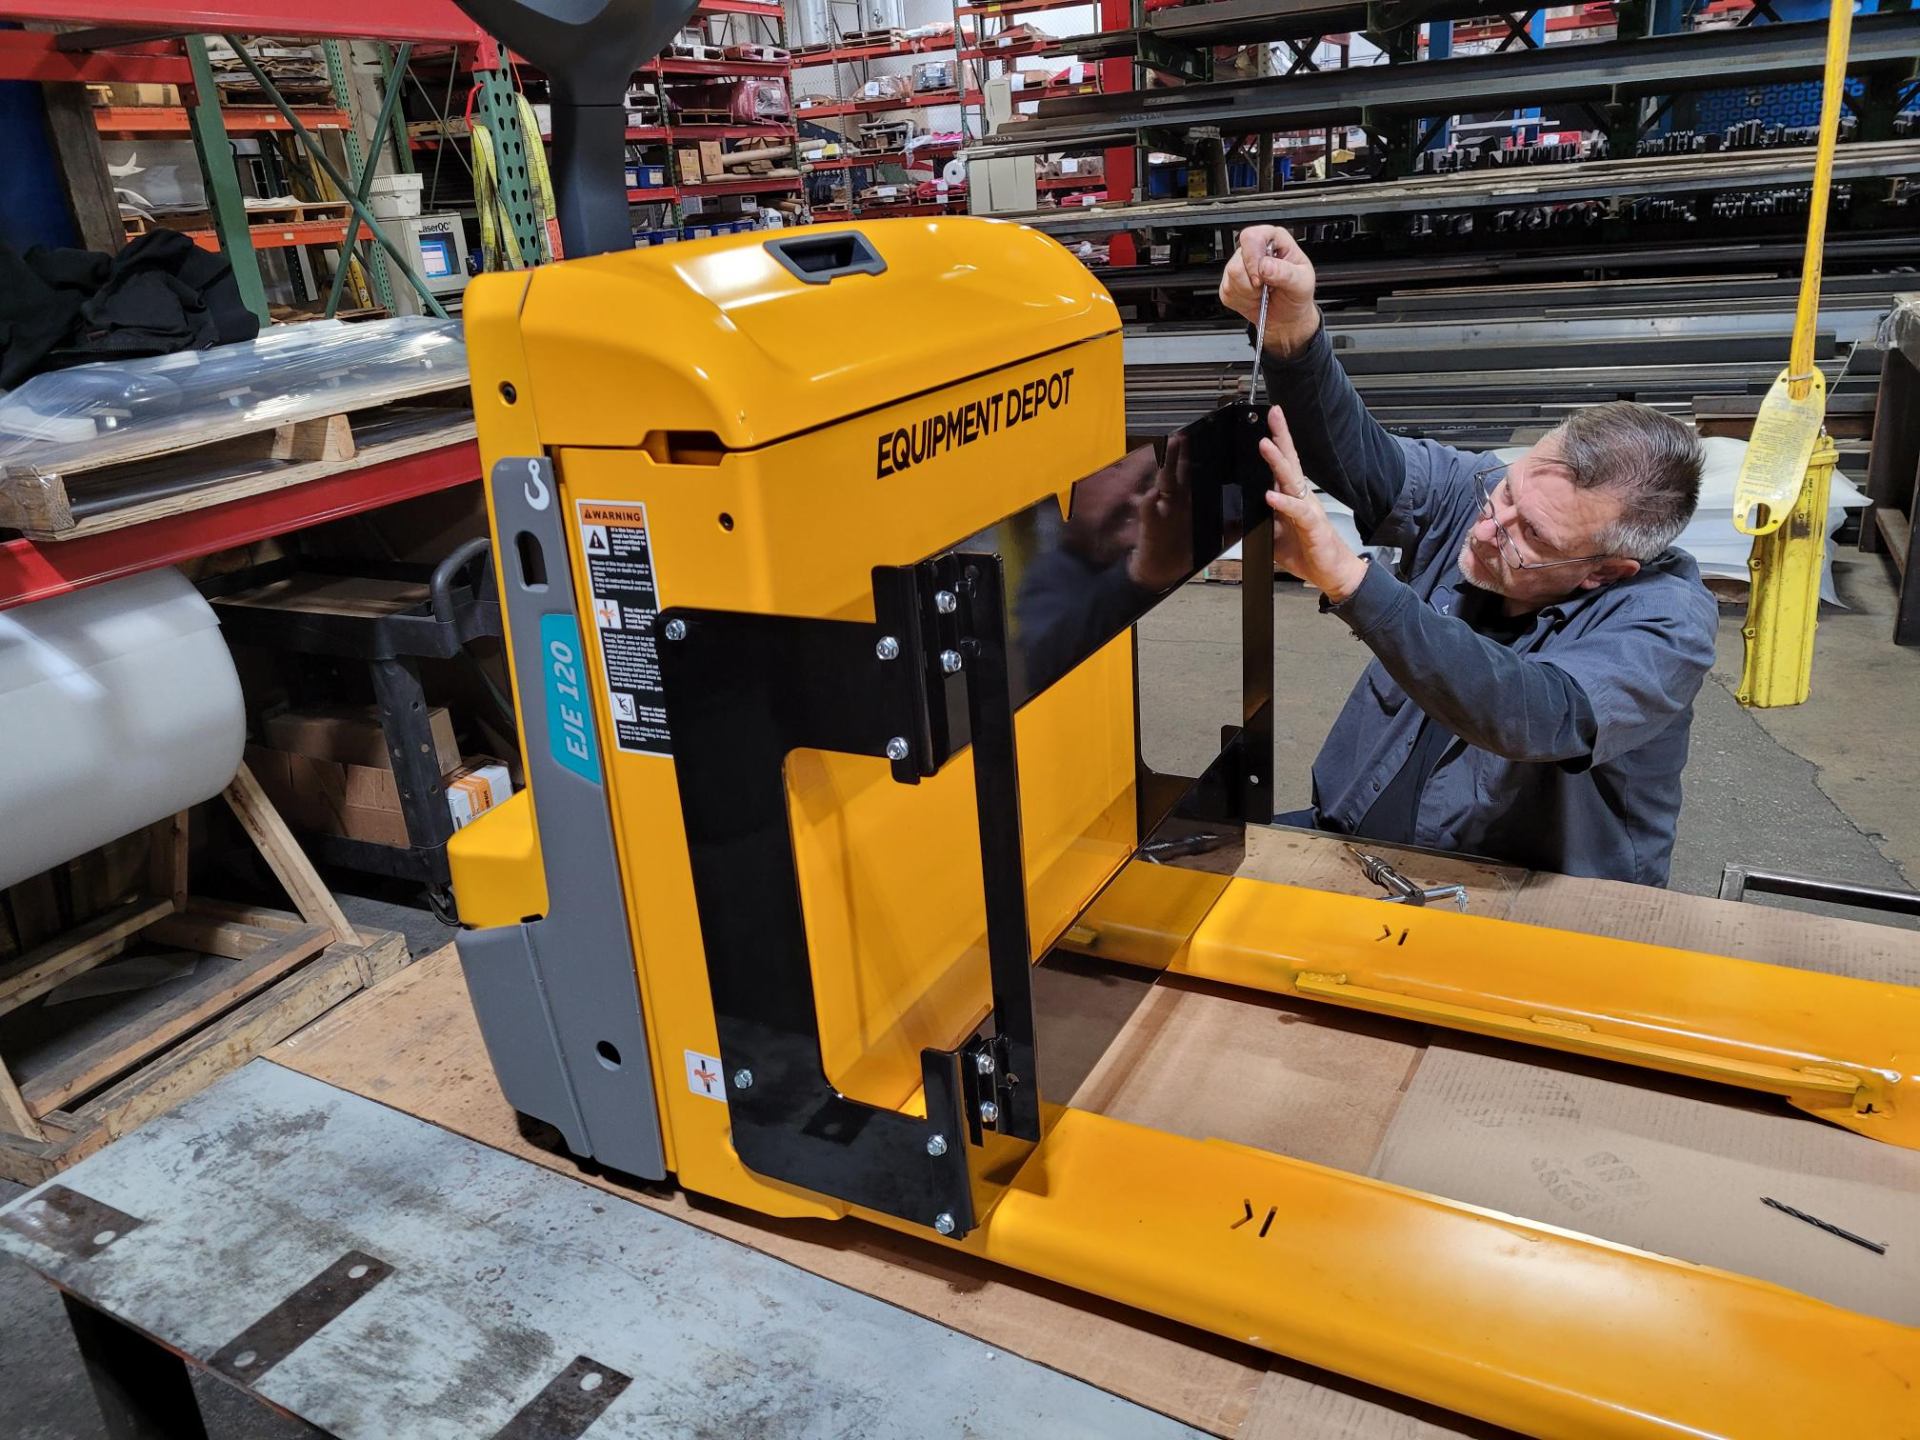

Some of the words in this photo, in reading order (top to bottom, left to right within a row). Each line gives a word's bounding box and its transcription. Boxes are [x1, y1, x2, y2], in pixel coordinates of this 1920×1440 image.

[419, 222, 450, 233] aserQC
[877, 392, 1004, 480] EQUIPMENT
[1006, 368, 1074, 428] DEPOT
[592, 510, 640, 521] WARNING
[550, 641, 580, 701] 120
[560, 704, 589, 760] EJE
